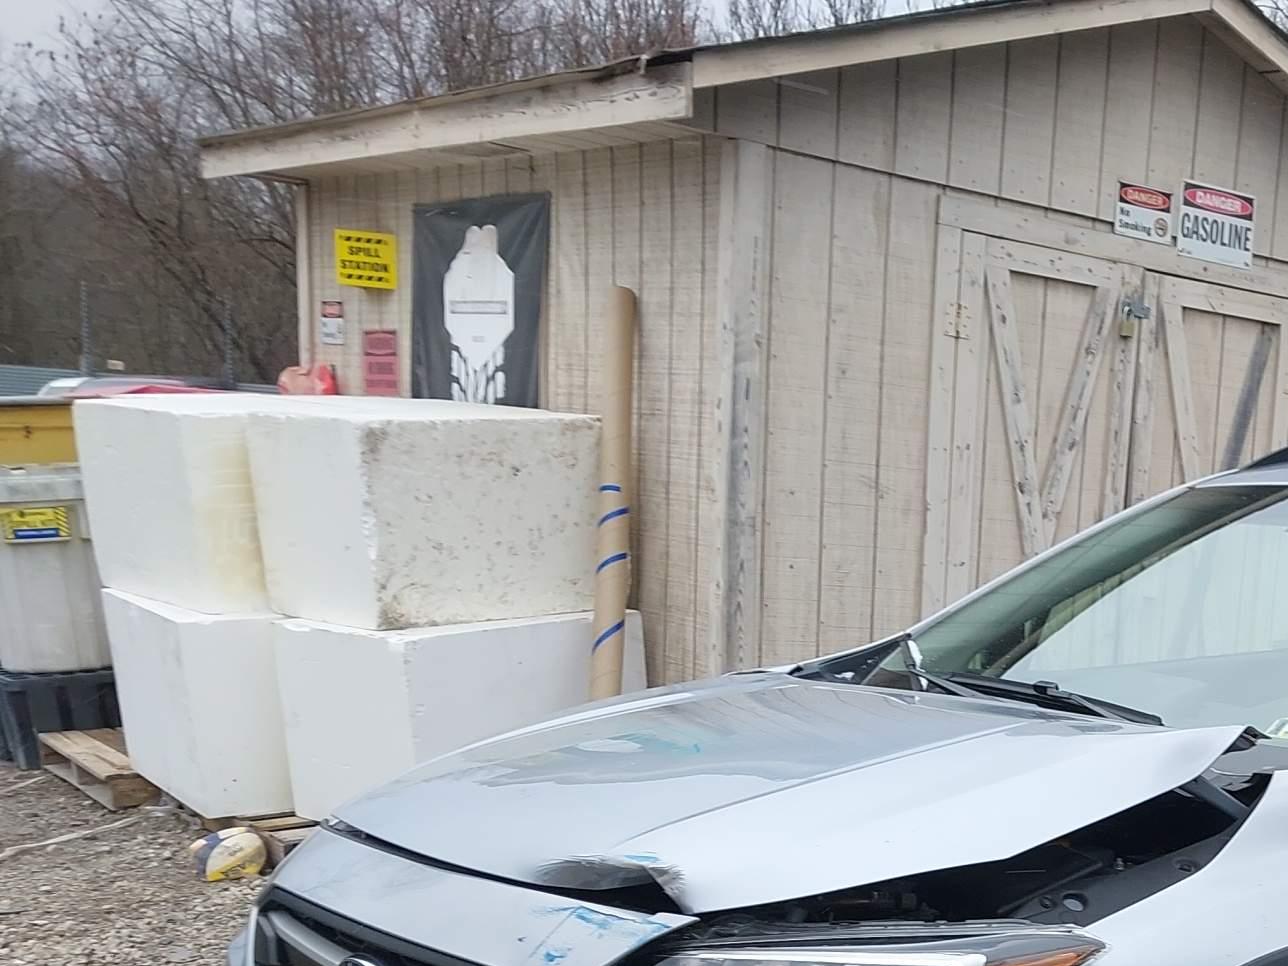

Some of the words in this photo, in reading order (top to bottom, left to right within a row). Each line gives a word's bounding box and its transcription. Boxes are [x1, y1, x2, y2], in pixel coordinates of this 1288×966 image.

[1196, 191, 1241, 212] DANGER
[1118, 218, 1152, 237] Smoking
[1182, 213, 1251, 251] GASOLINE
[347, 246, 381, 258] SPILL
